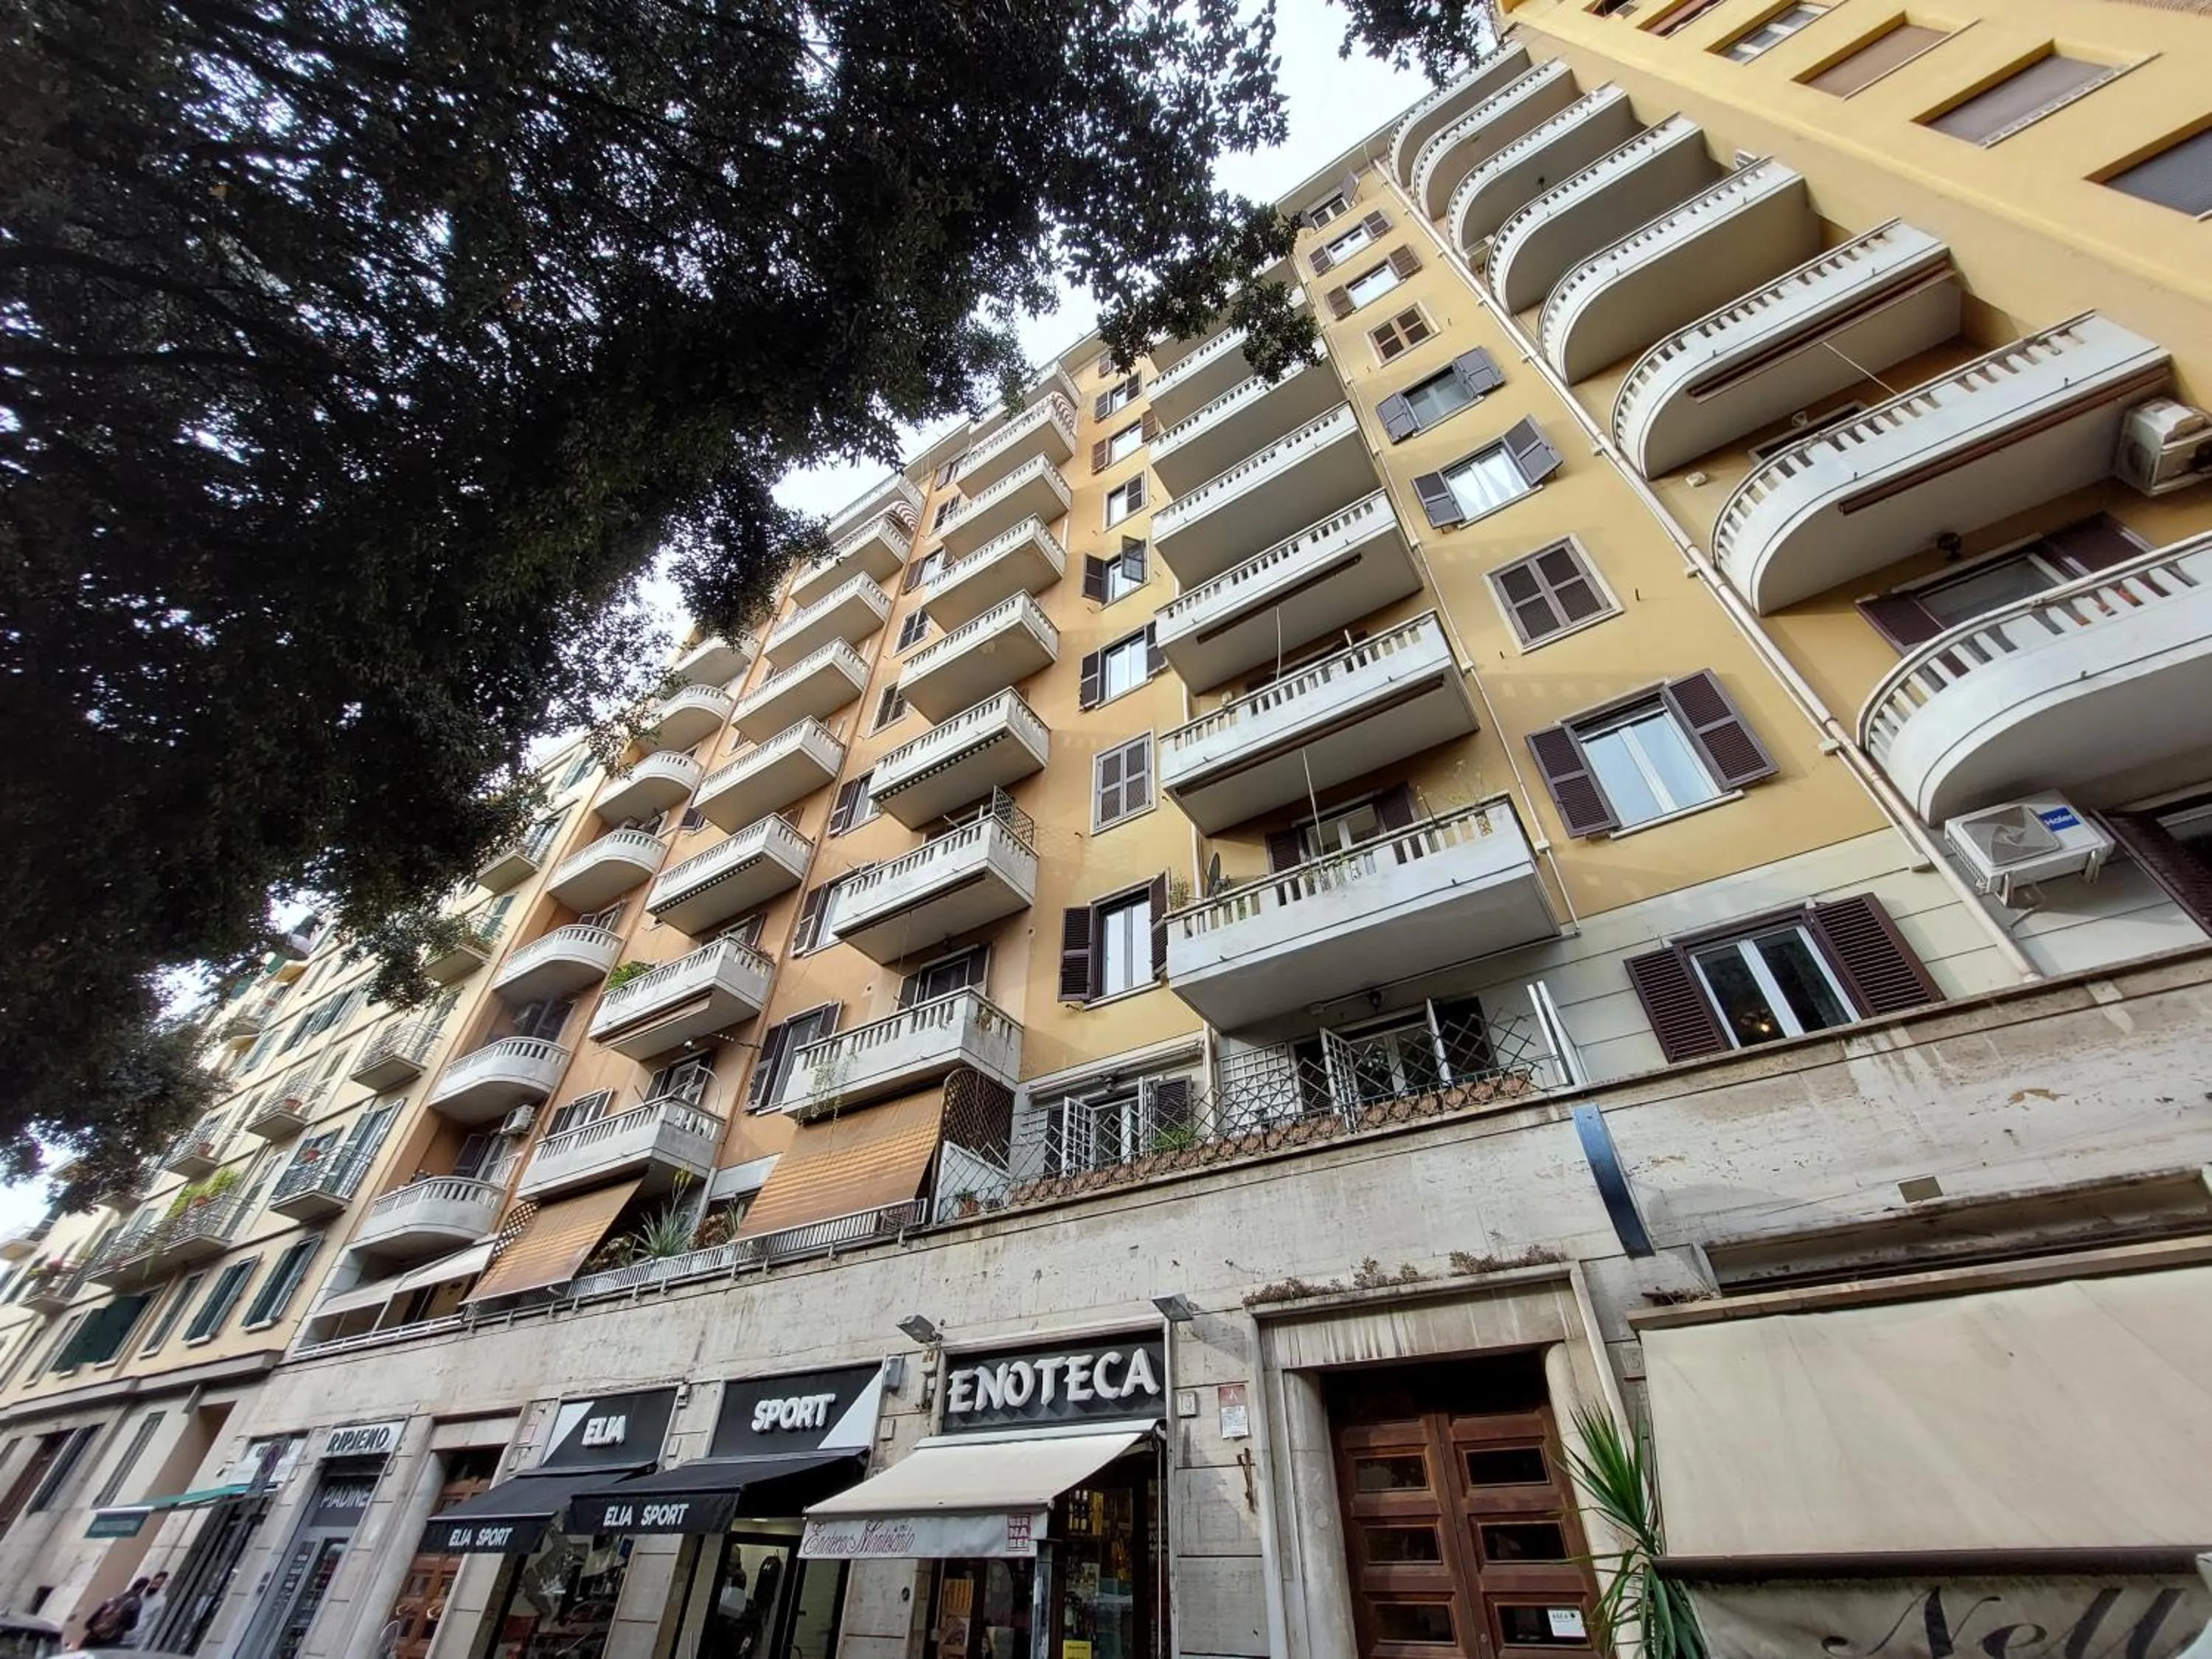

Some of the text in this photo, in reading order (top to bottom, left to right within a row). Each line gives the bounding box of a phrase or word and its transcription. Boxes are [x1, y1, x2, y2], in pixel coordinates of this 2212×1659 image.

[947, 1348, 1161, 1413] ENOTECA
[751, 1394, 835, 1432] SPORT
[582, 1416, 627, 1446] ELIA
[603, 1504, 689, 1526] ELIA SPORT
[448, 1527, 514, 1546] ELIA SPORT
